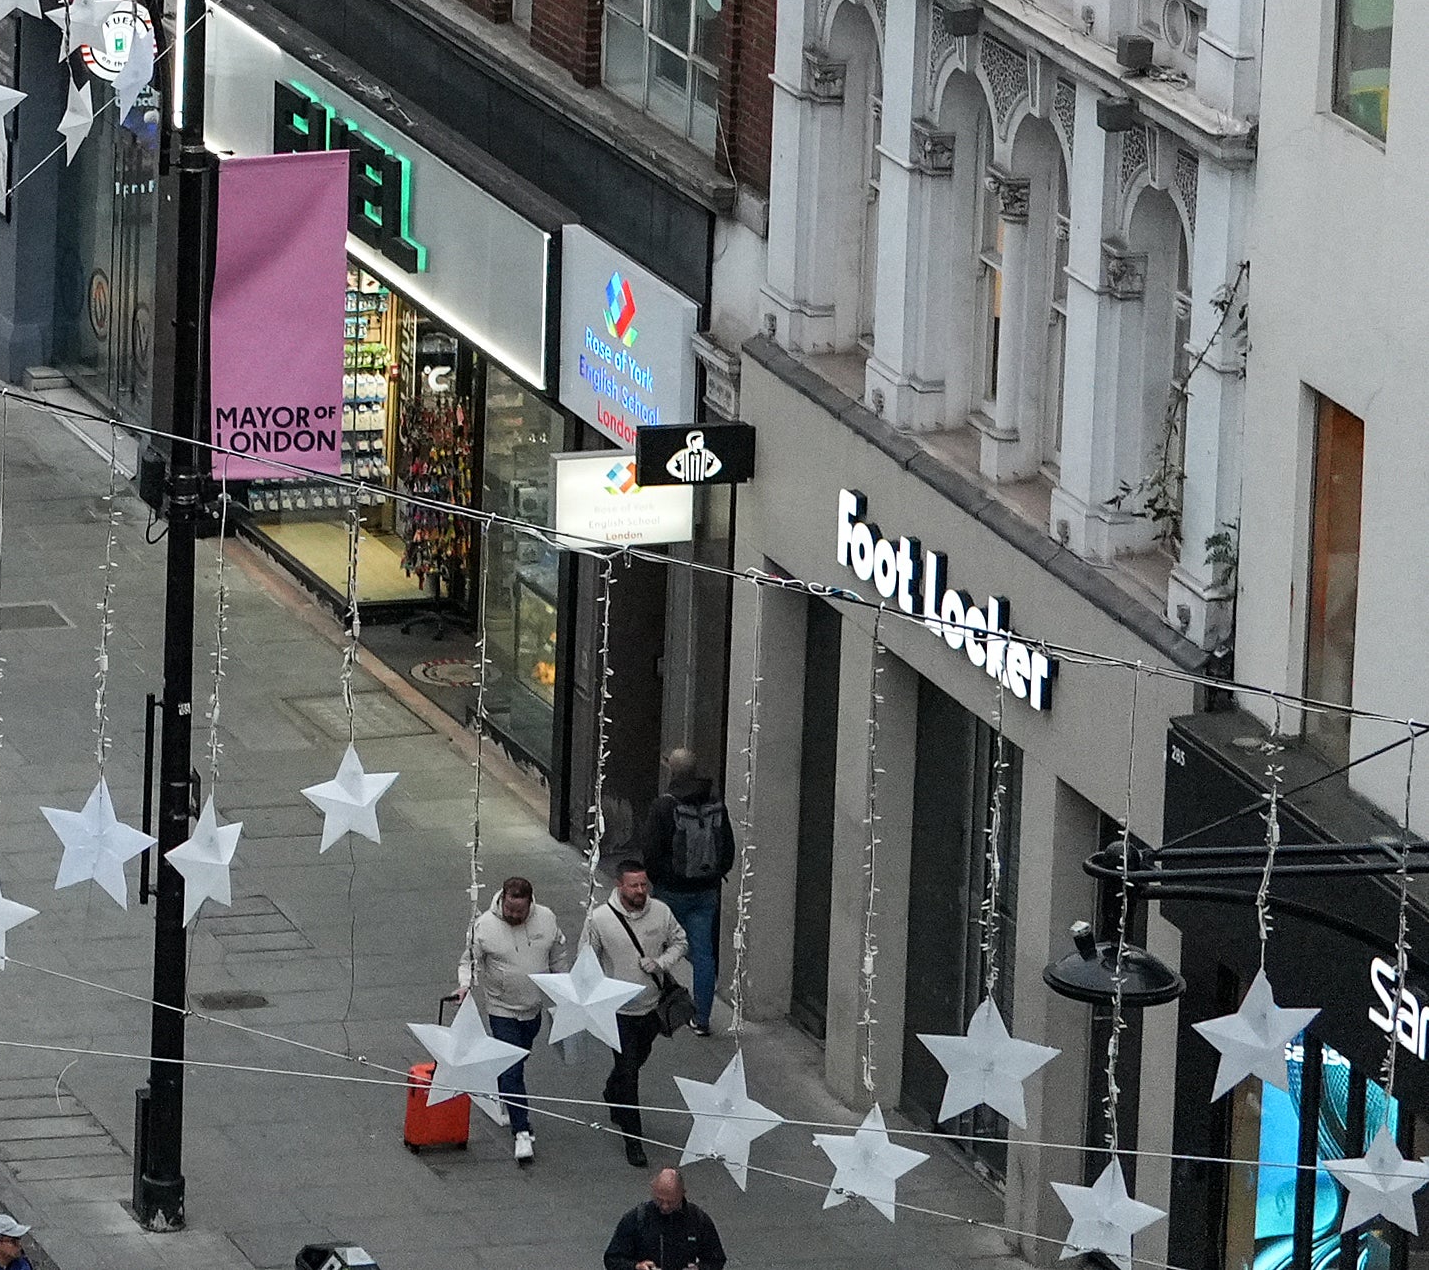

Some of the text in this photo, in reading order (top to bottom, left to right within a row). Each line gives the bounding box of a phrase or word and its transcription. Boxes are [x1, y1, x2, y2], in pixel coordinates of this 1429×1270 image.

[104, 14, 137, 30] FUEL
[584, 324, 655, 394] Rose of York
[579, 353, 660, 426] English School
[216, 405, 337, 430] MAYOR OF
[216, 429, 337, 455] LONDON
[589, 515, 661, 530] English School
[605, 530, 643, 542] London
[836, 488, 1052, 711] Foot Locker
[1369, 956, 1429, 1062] Sa
